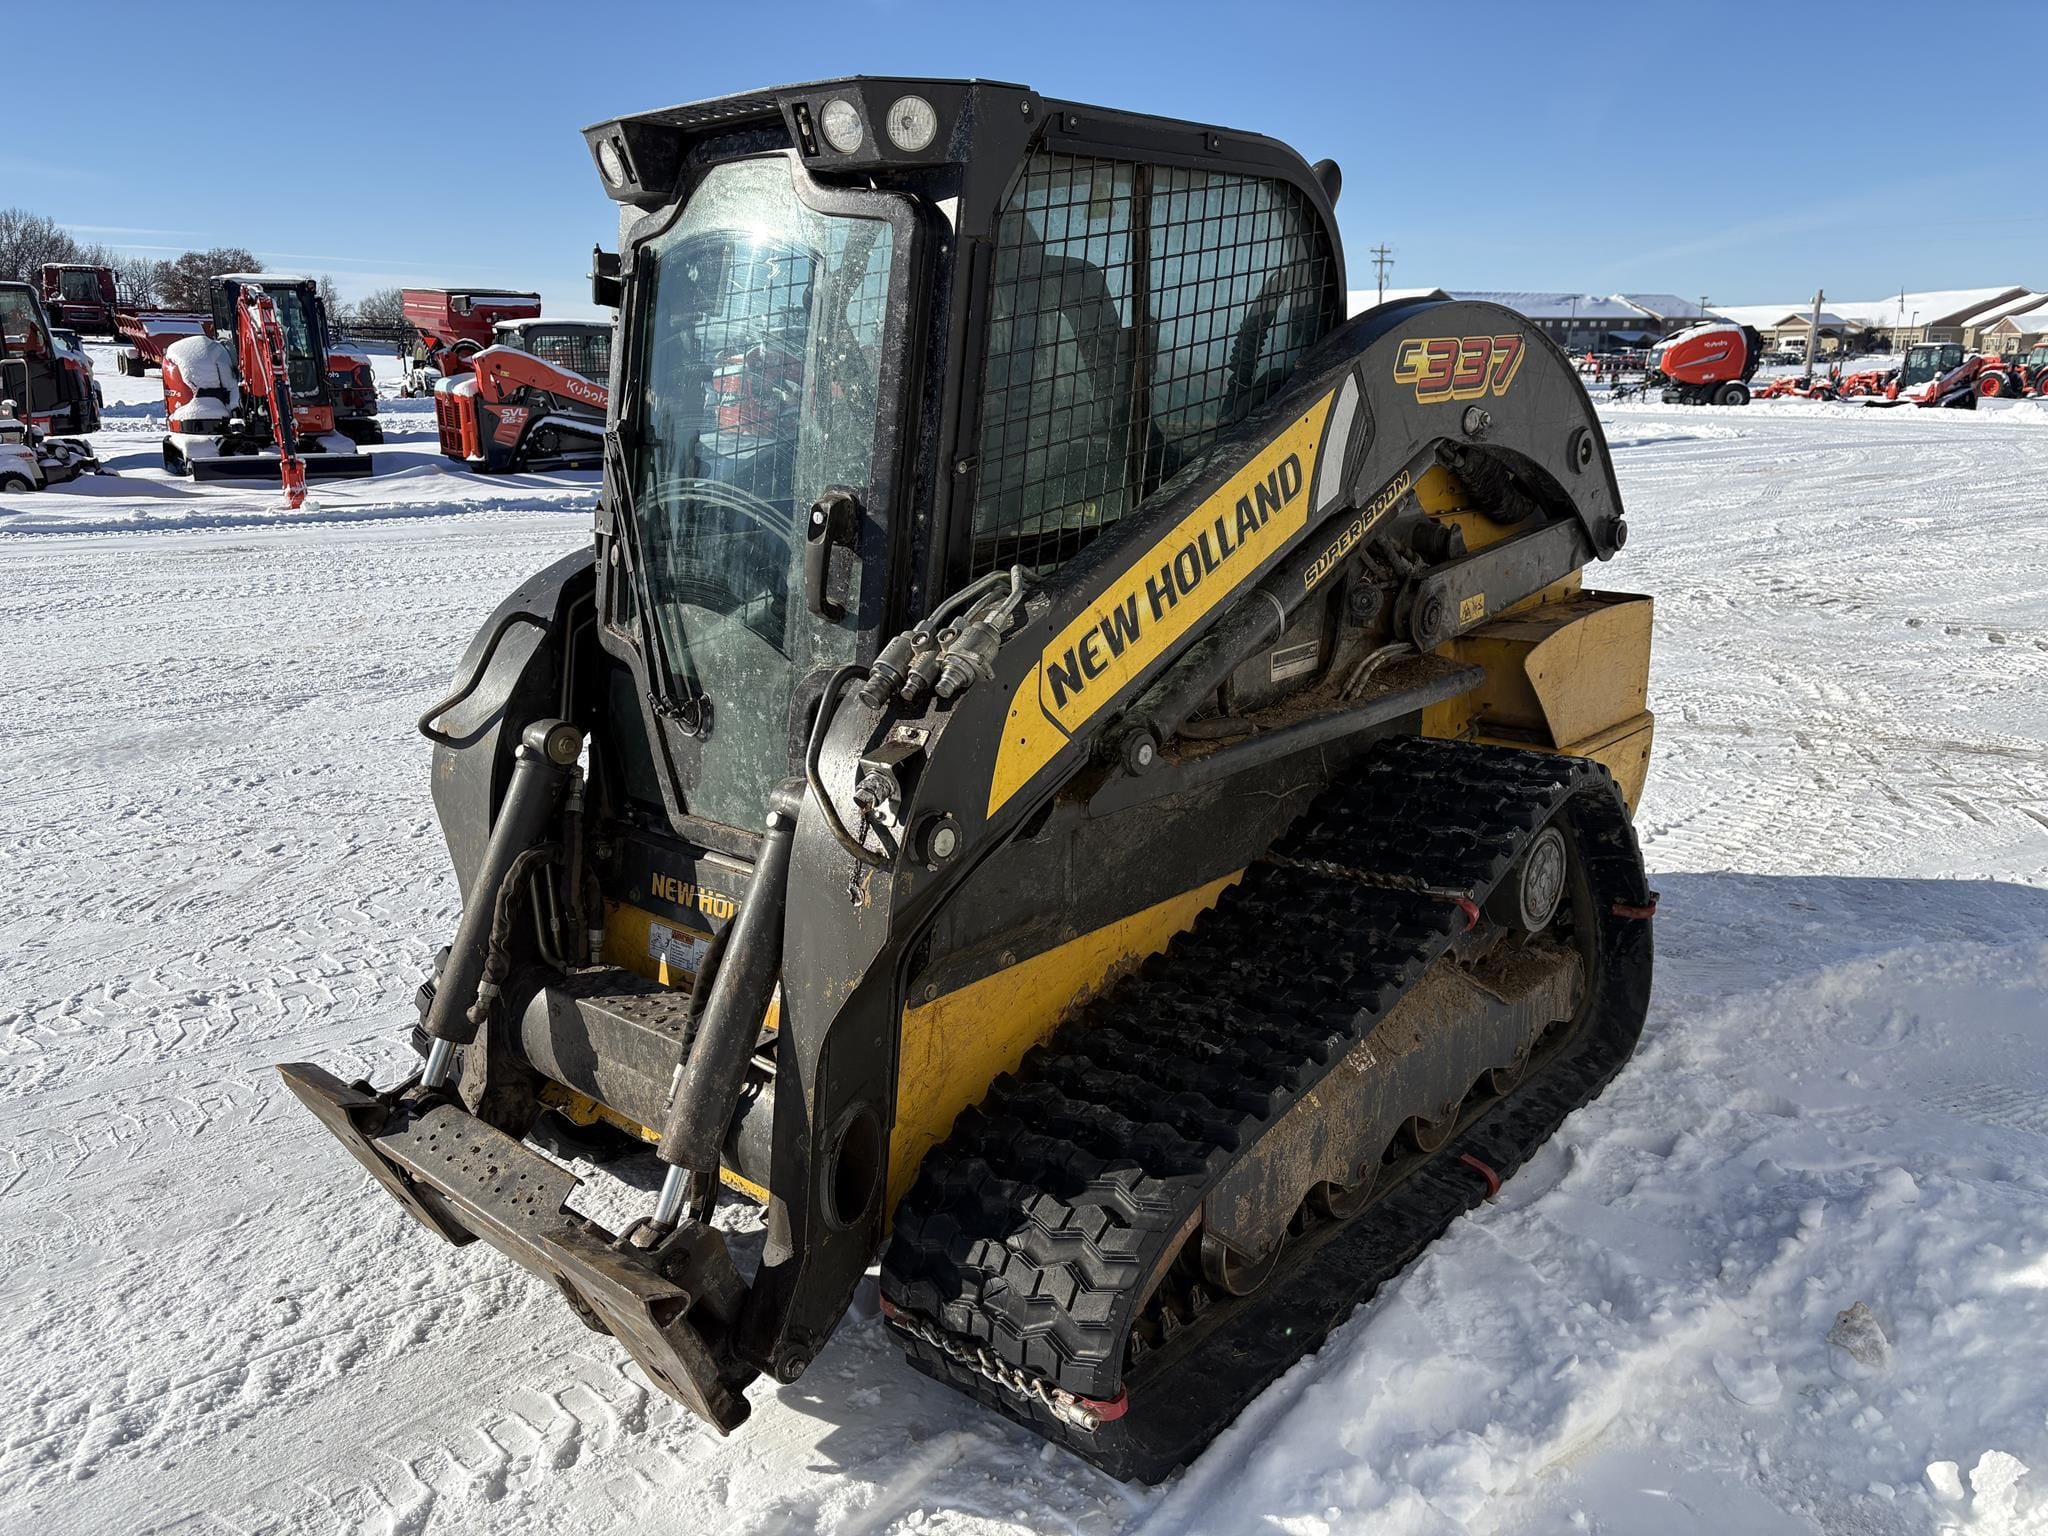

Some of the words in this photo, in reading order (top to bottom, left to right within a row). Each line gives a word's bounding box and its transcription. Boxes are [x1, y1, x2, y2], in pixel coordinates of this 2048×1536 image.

[1394, 334, 1526, 404] C337
[501, 408, 528, 417] SVL
[1304, 519, 1362, 591] SUPER
[1362, 469, 1410, 531] BOOM
[1046, 592, 1141, 710] NEW
[1144, 452, 1304, 623] HOLLAND
[652, 872, 695, 907] NEW
